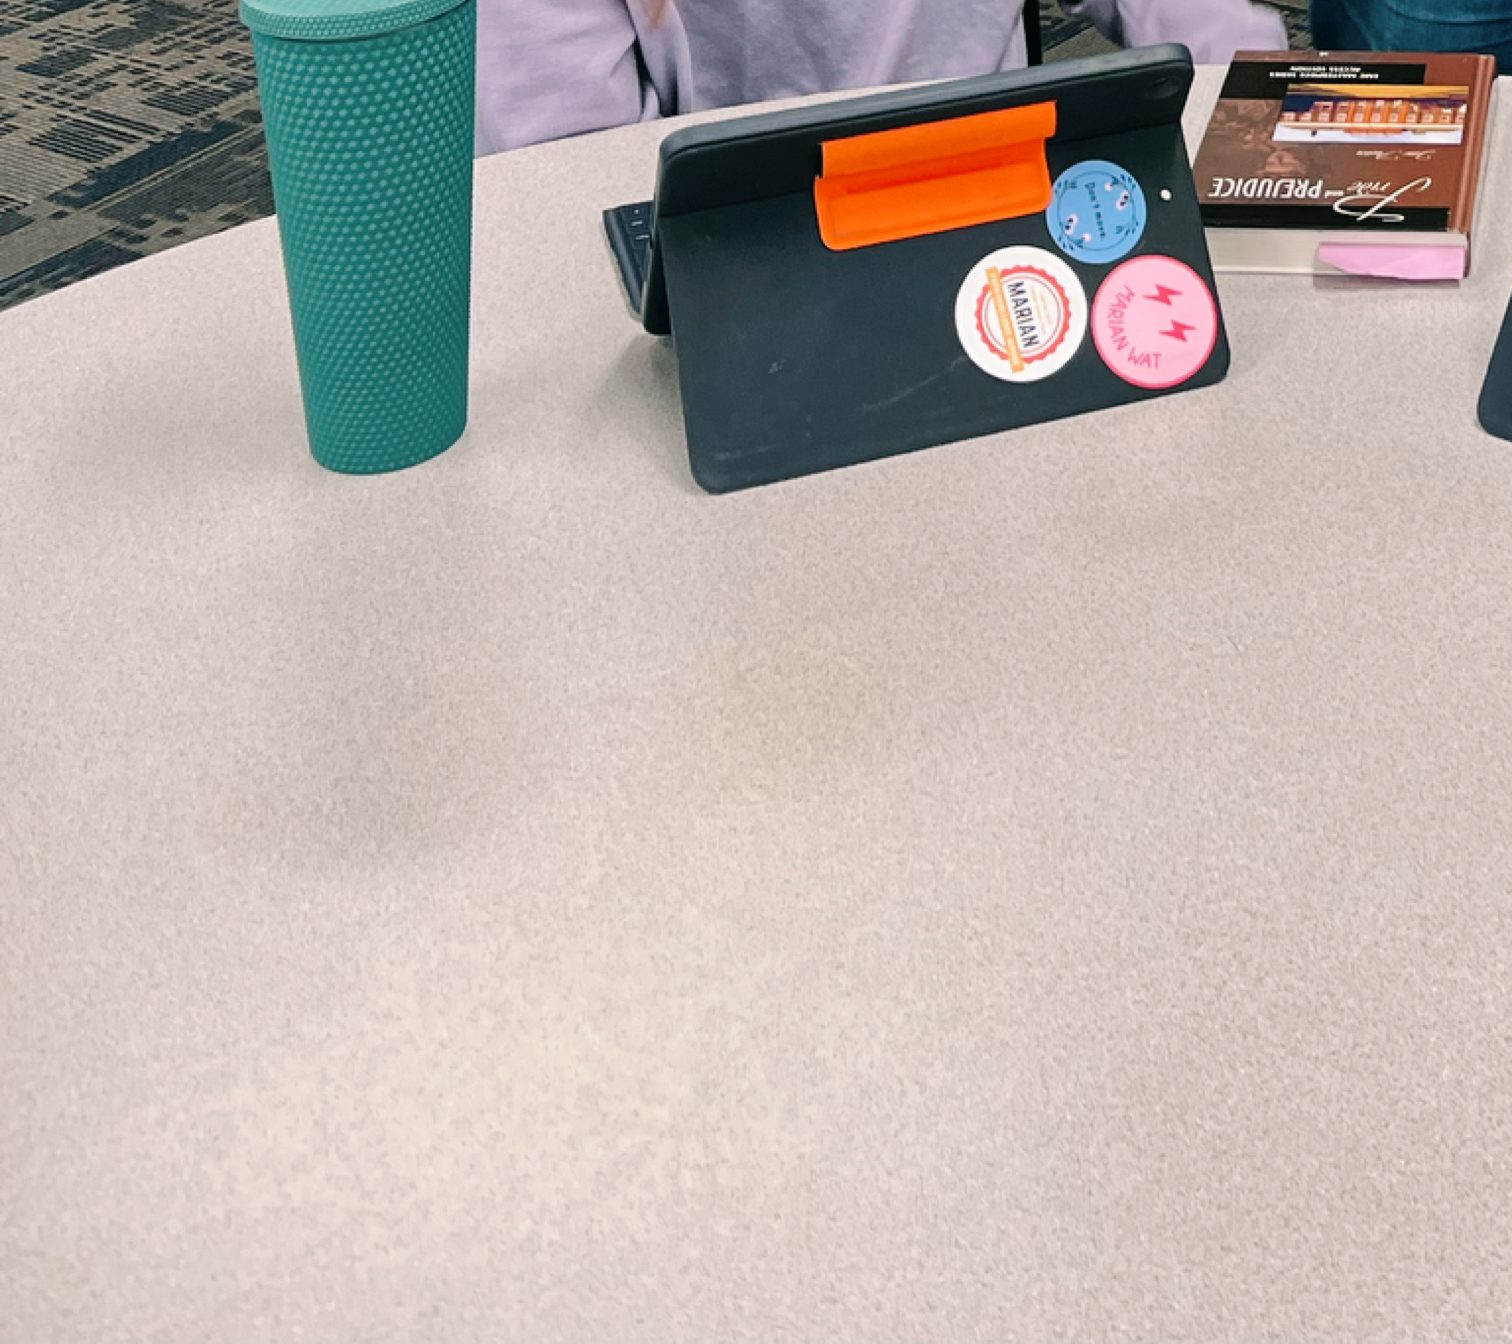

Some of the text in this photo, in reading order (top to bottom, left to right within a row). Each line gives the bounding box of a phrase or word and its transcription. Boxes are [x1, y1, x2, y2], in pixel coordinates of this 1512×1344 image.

[1208, 177, 1323, 200] PREJUDICE
[1332, 175, 1432, 222] Pride
[1007, 280, 1040, 349] MARIAN
[1106, 284, 1162, 370] MARIAN WAT
